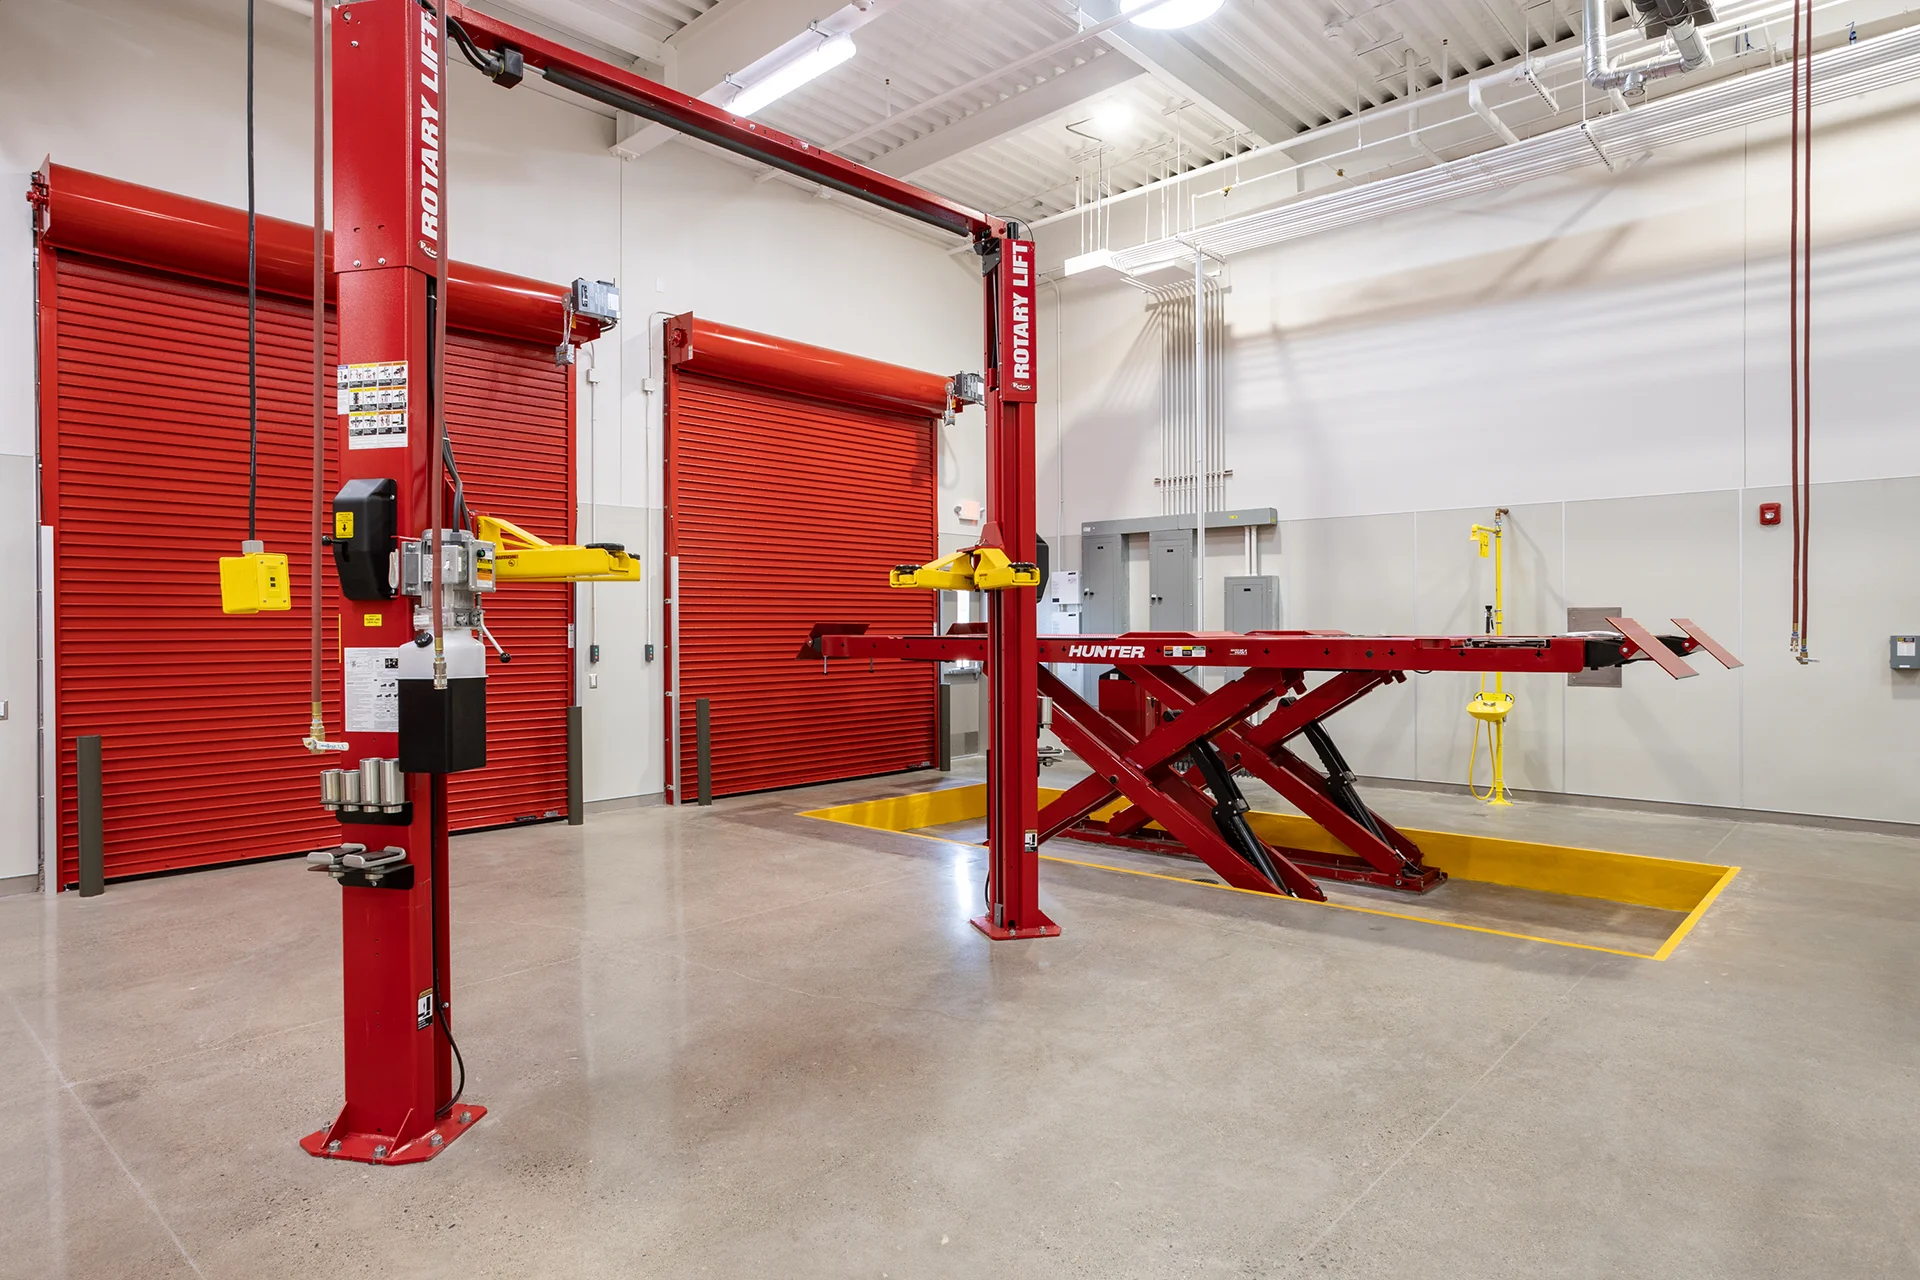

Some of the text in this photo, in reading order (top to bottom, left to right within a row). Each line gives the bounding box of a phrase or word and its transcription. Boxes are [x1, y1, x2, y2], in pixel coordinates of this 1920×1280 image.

[421, 11, 438, 241] ROTARY LIFT
[1012, 242, 1030, 379] ROTARY LIFT
[1068, 645, 1145, 658] HUNTER
